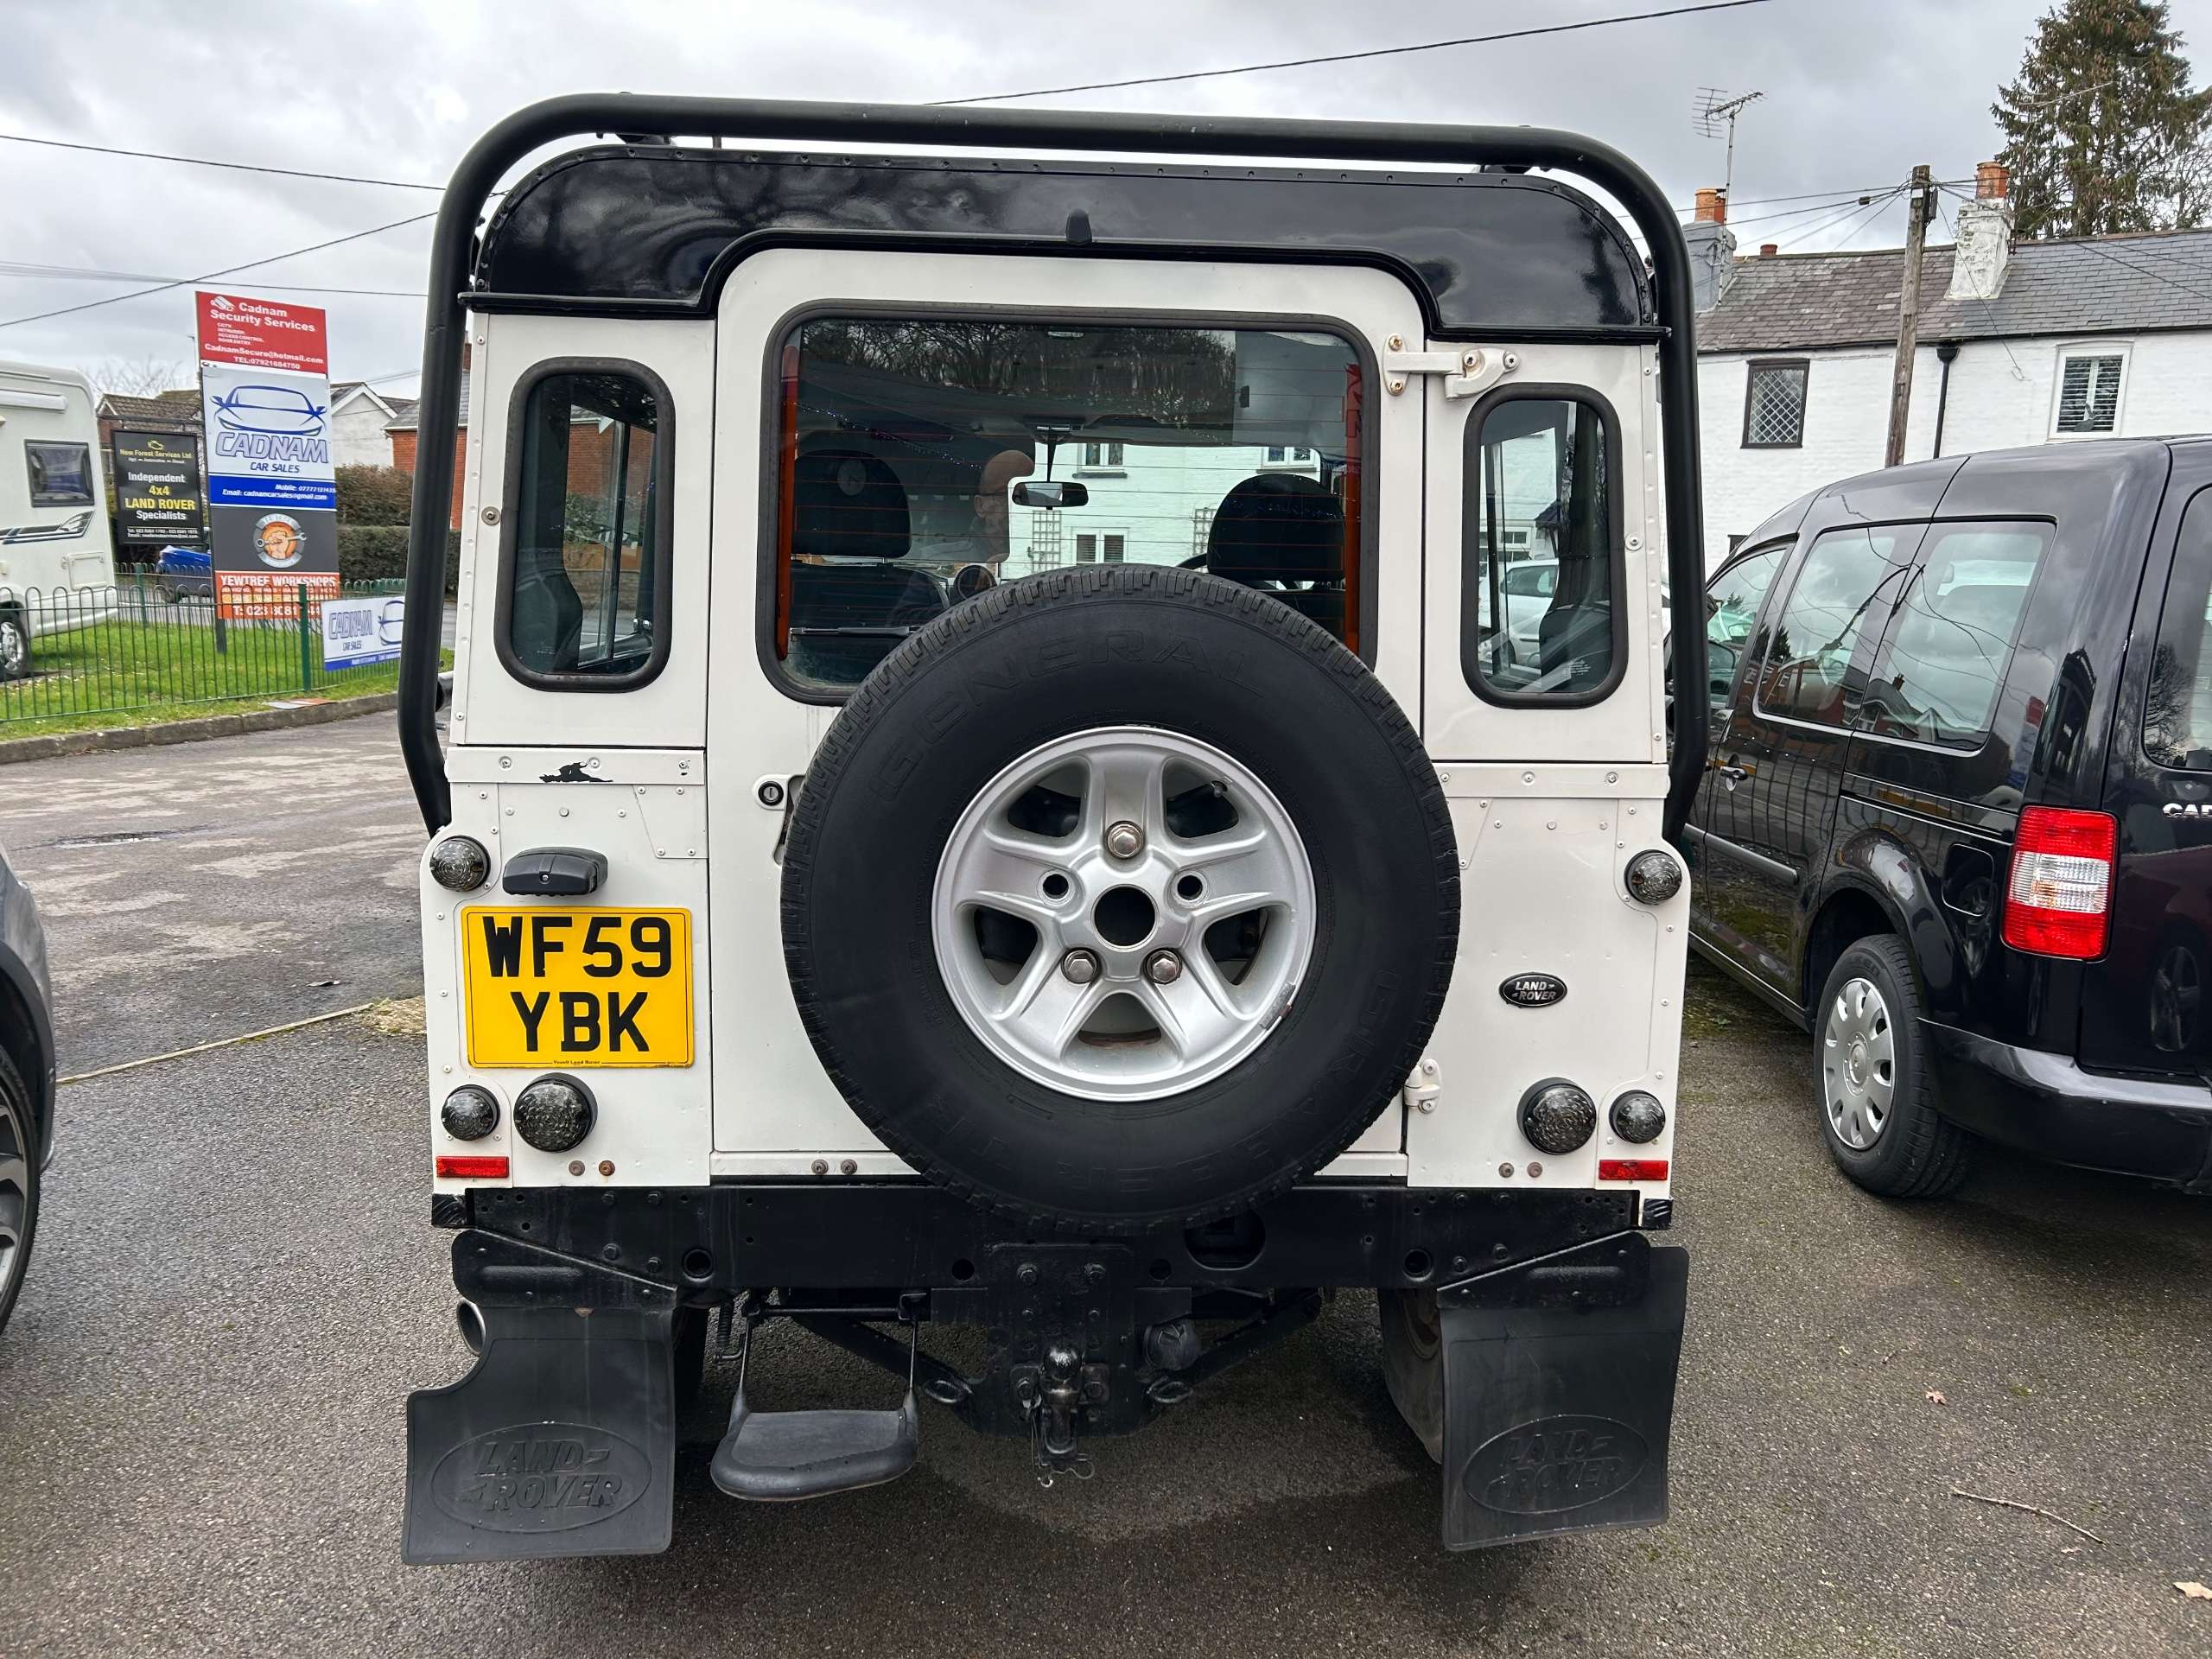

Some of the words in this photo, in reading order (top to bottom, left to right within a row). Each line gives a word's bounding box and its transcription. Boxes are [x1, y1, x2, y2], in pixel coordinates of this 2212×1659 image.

[238, 302, 287, 317] Cadnam
[210, 310, 261, 326] Security
[264, 317, 315, 332] Services
[216, 432, 328, 463] CADNAM
[250, 461, 269, 471] CAR
[271, 464, 300, 473] SALES
[128, 472, 186, 483] Independent
[148, 485, 170, 496] 4x4
[222, 488, 243, 497] Email:
[124, 498, 156, 509] LAND
[158, 499, 196, 510] ROVER
[136, 510, 187, 521] Specialists
[329, 610, 372, 639] CADNAM
[868, 627, 1266, 804] GENERAL
[481, 916, 671, 977] WF59
[1515, 981, 1547, 990] LAND
[1518, 991, 1556, 1000] ROVER
[510, 992, 650, 1052] YBK
[475, 1439, 585, 1474] LAND
[482, 1472, 623, 1512] ROVER
